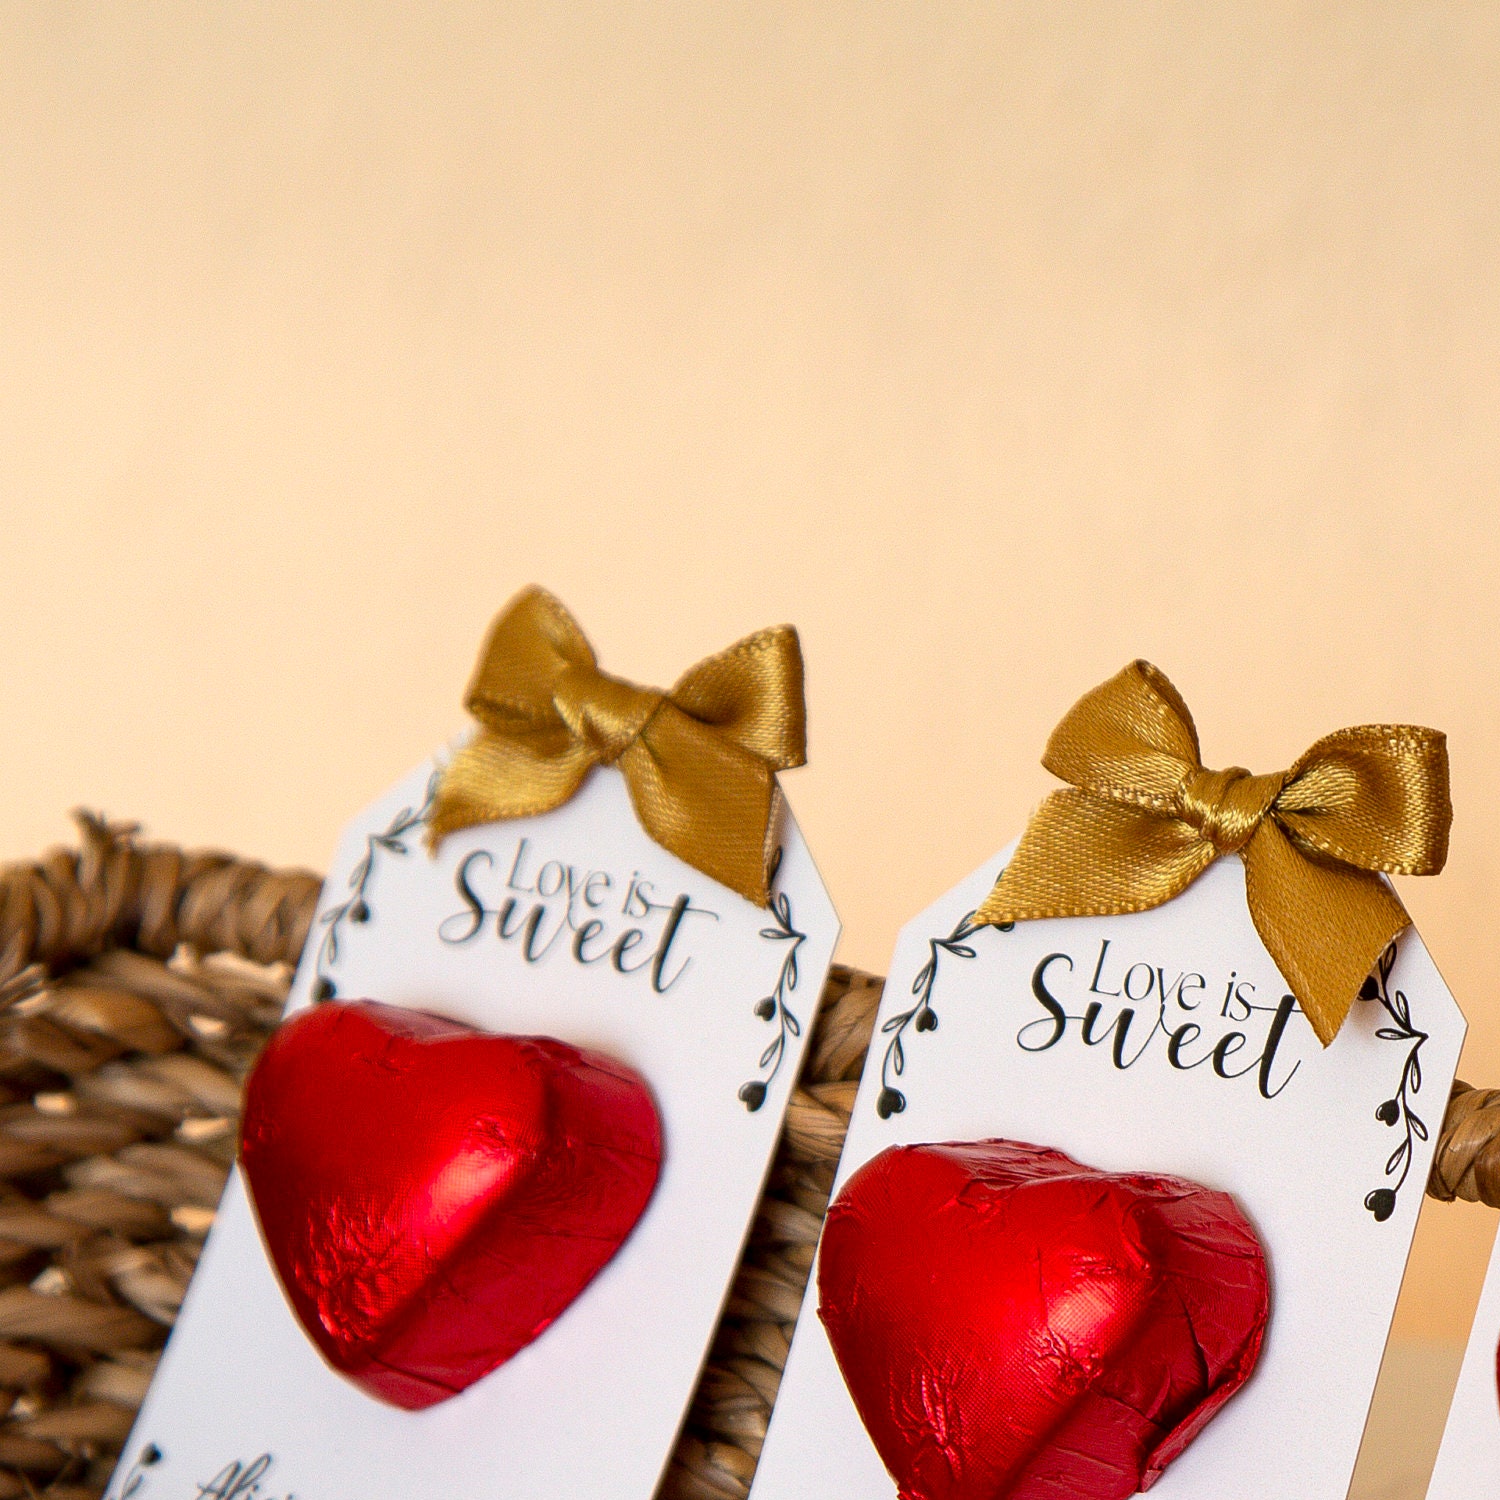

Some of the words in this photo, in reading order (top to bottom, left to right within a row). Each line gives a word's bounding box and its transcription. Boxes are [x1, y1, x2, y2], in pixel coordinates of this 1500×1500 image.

[438, 849, 720, 993] Sweet
[505, 838, 611, 908] Love
[622, 870, 655, 919] is
[1016, 952, 1306, 1099] Sweet
[1088, 939, 1206, 1011] Love
[1220, 971, 1256, 1022] is
